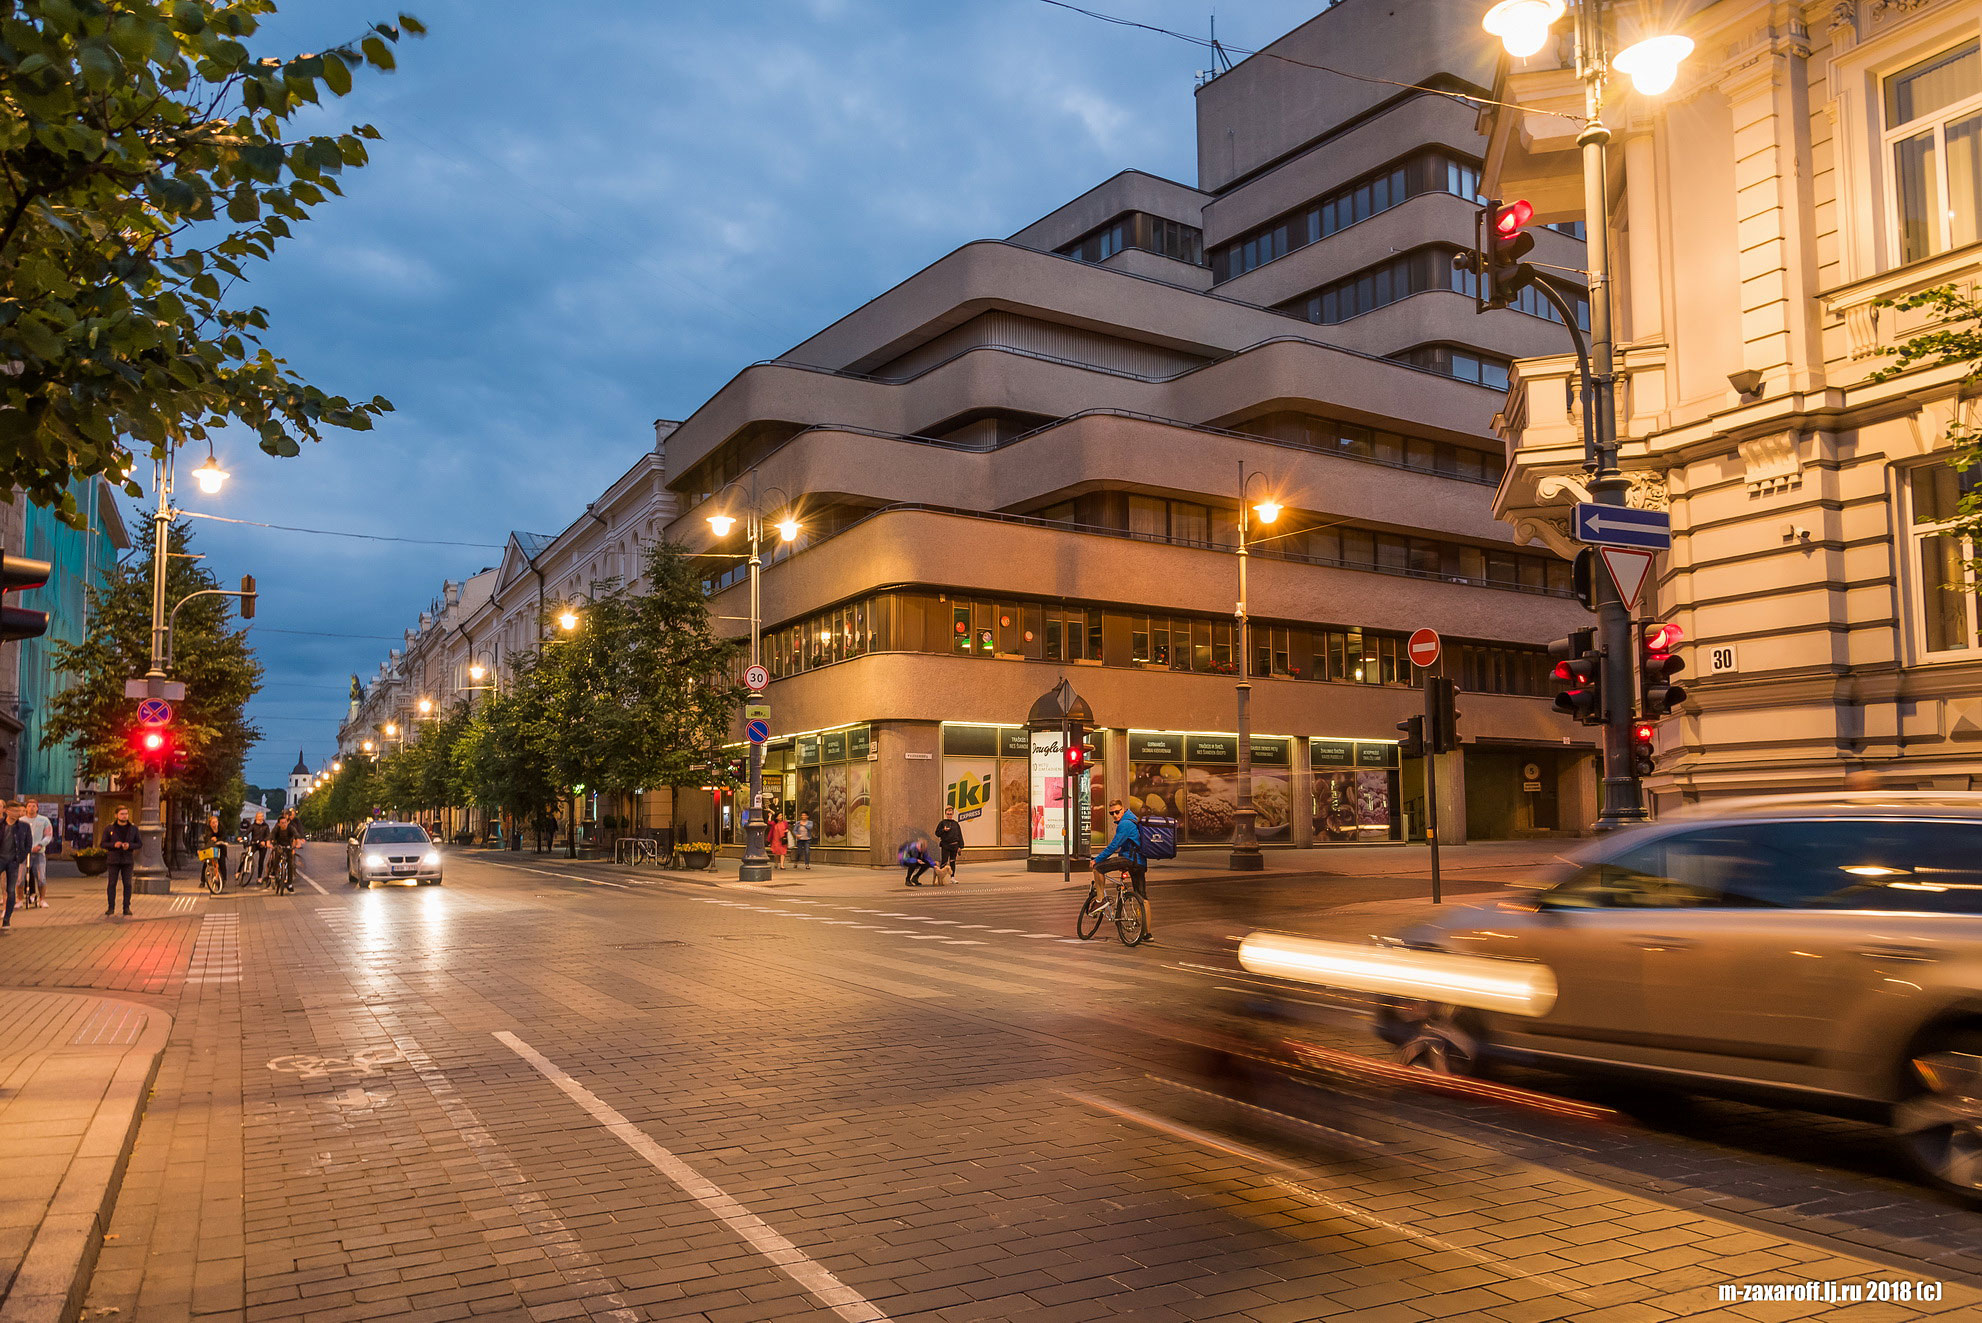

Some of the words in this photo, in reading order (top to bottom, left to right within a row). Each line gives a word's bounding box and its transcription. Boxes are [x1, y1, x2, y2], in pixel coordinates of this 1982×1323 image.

[1713, 649, 1732, 669] 30
[750, 673, 763, 683] 30
[947, 774, 991, 809] iki
